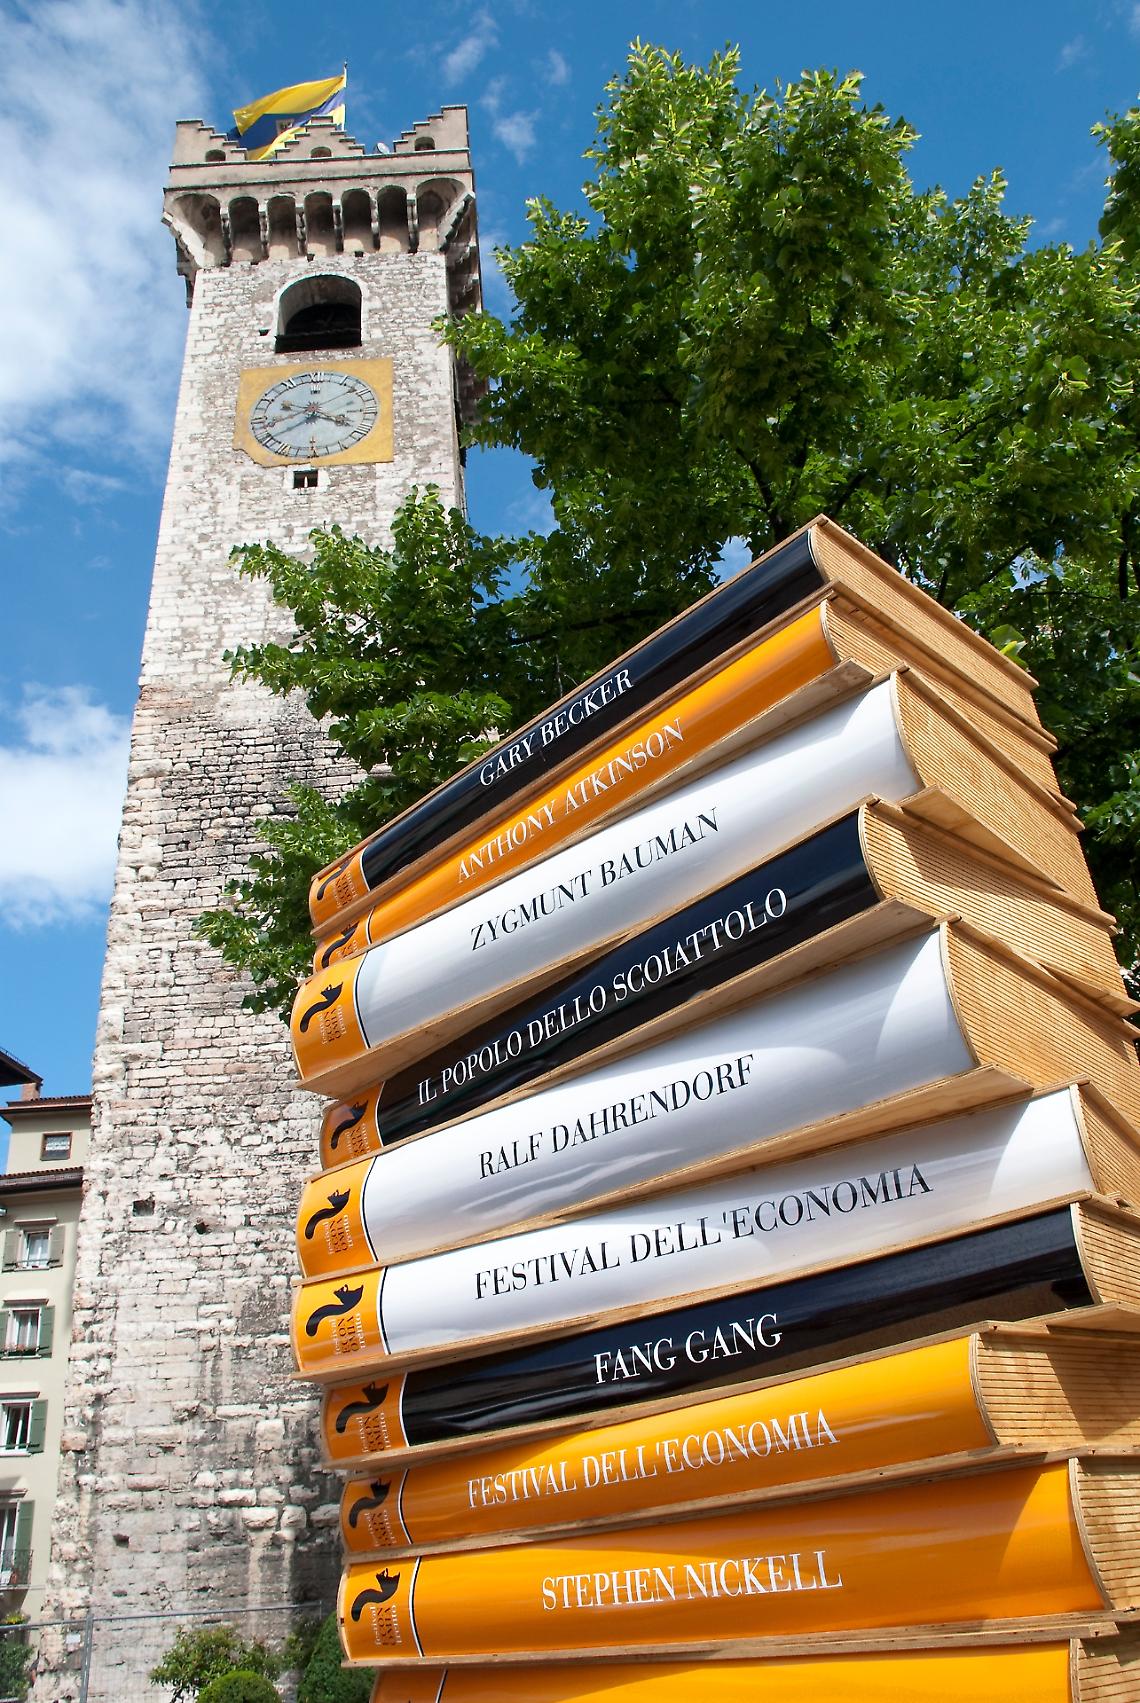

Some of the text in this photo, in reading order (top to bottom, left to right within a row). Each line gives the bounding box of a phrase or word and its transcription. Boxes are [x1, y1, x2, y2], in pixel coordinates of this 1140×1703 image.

[480, 668, 634, 786] GARY BECKER
[458, 717, 684, 884] ANTHONY ATKINSON
[470, 807, 719, 951] ZYGMUNT BAUMAN
[417, 888, 787, 1106] IL POPOLO DELLO SCOIATTOLO
[478, 1054, 754, 1180] RALF DAHRENDORF
[474, 1241, 621, 1300] FESTIVAL
[593, 1313, 783, 1385] FANG GANG
[467, 1461, 576, 1508] FESTIVAL
[542, 1550, 843, 1611] STEPHEN NICKELL
